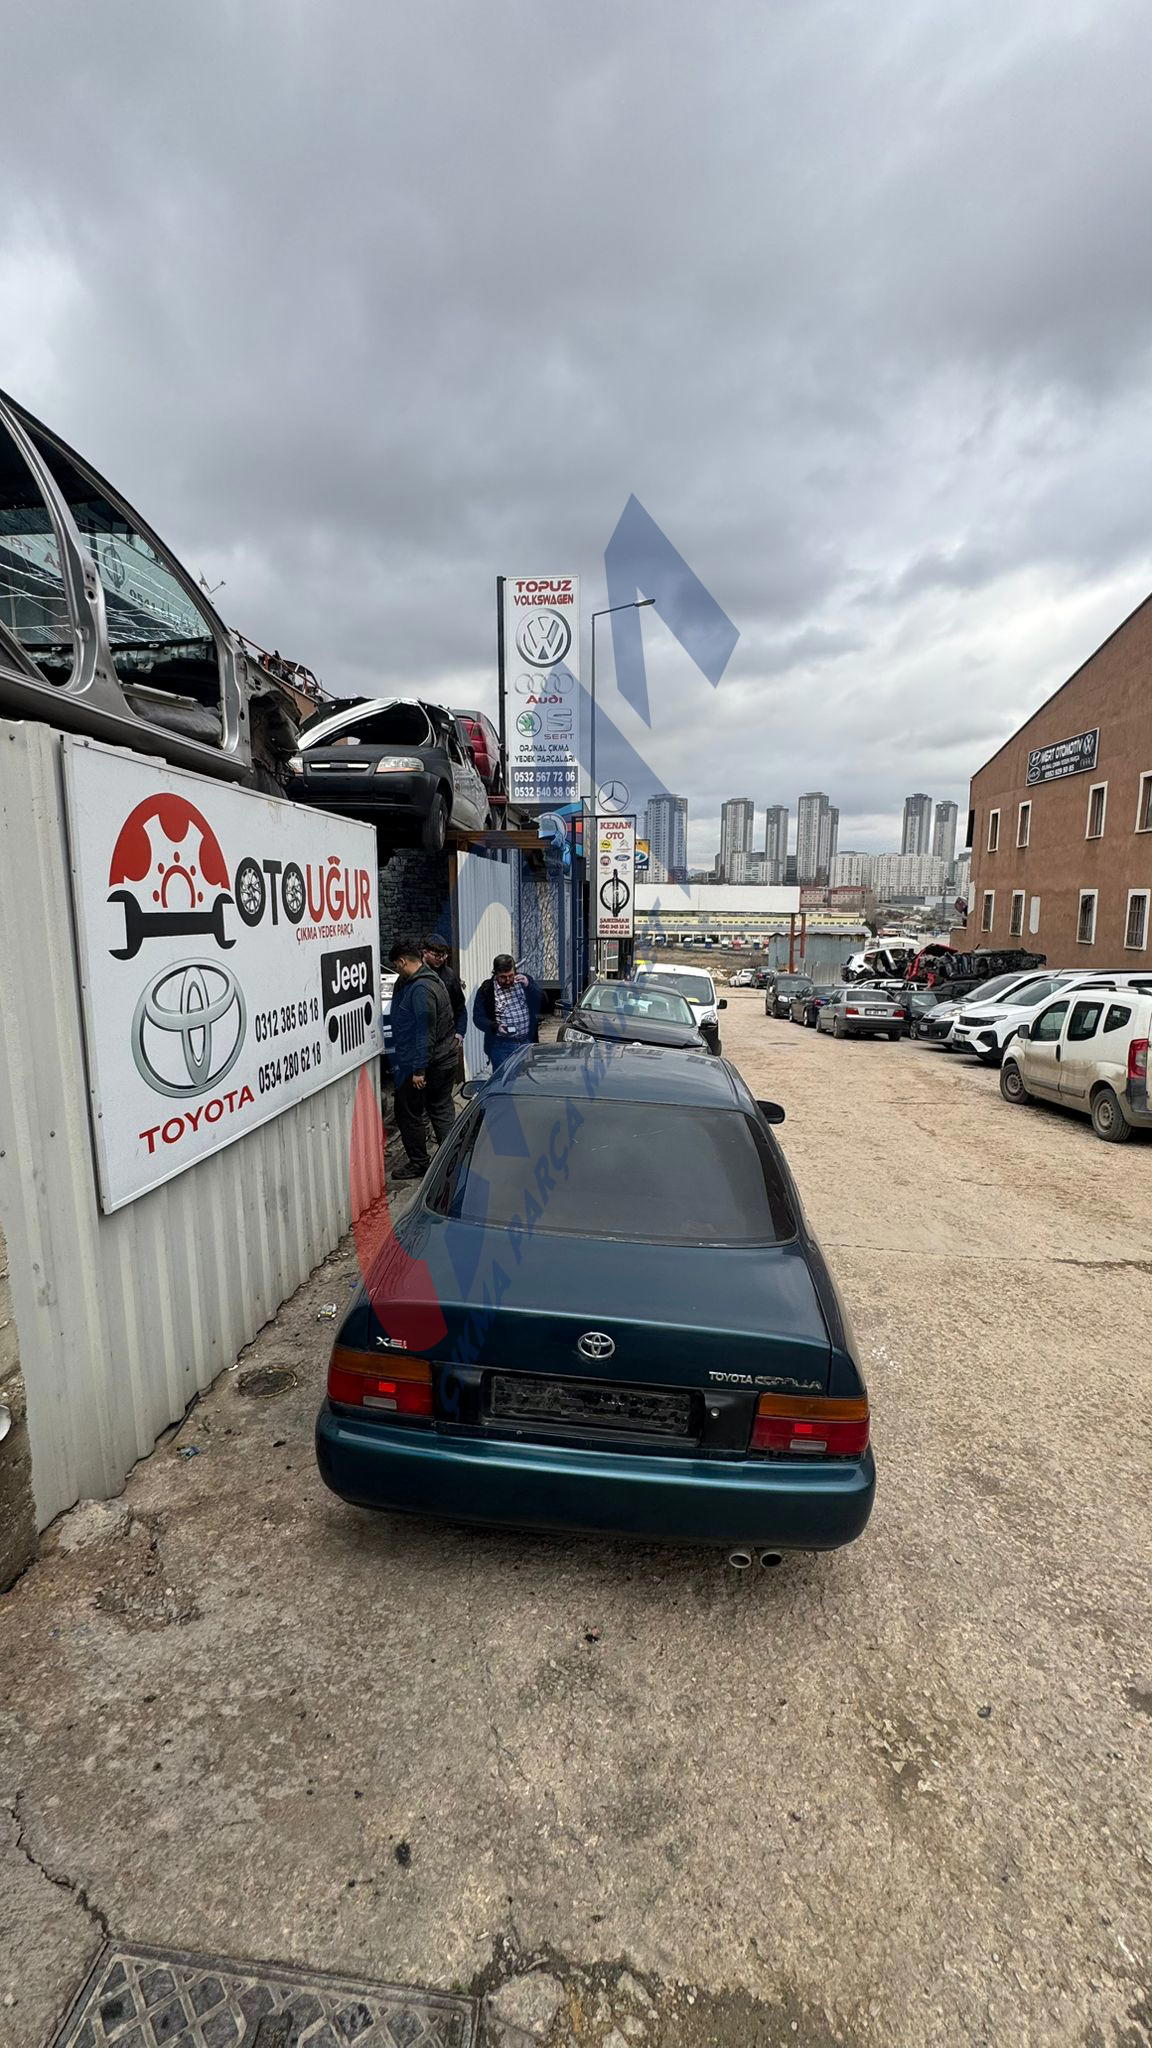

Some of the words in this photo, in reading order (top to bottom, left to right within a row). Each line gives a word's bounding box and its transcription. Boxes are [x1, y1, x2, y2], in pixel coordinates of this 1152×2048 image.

[515, 580, 572, 593] TOPUZ
[514, 594, 574, 606] VOLKSWAGEN
[548, 744, 570, 753] ÇIKMA
[514, 755, 535, 763] YEDEK
[514, 771, 534, 782] 0532
[536, 771, 550, 782] 567
[553, 771, 563, 782] 72
[565, 770, 575, 782] 06
[514, 786, 534, 797] 0532
[536, 786, 551, 797] 540
[553, 786, 563, 797] 38
[565, 786, 575, 797] 06
[600, 821, 632, 830] KENAN
[606, 831, 624, 840] OTO
[296, 927, 318, 945] ÇIKMA
[319, 925, 336, 939] YEDEK
[337, 923, 354, 938] PARÇA
[331, 959, 368, 994] Jeep
[255, 1010, 279, 1043] 0312
[280, 1004, 296, 1033] 385
[298, 1001, 308, 1027] 68
[310, 997, 319, 1022] 18
[258, 1059, 282, 1094] 0534
[283, 1051, 299, 1082] 280
[300, 1046, 311, 1072] 62
[312, 1041, 321, 1067] 18
[139, 1085, 255, 1154] TOYOTA
[709, 1371, 753, 1384] TOYOTA
